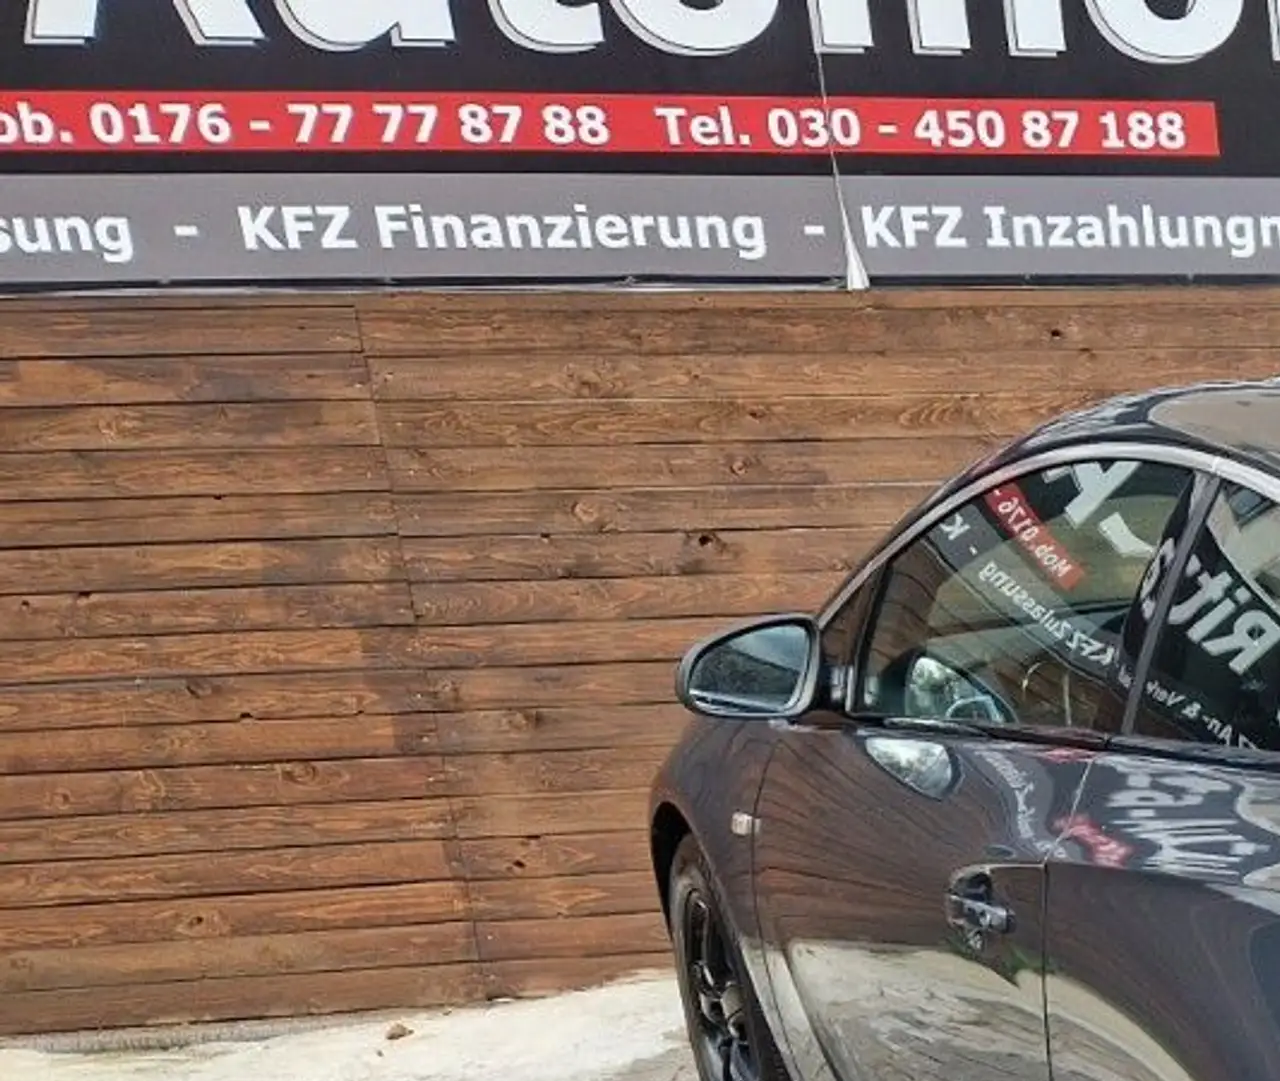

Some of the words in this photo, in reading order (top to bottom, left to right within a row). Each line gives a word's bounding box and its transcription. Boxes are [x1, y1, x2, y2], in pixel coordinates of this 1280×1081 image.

[89, 102, 231, 145] 0176
[249, 120, 270, 131] -
[287, 103, 353, 143] 77
[372, 104, 438, 143] 77
[458, 103, 522, 144] 87
[542, 104, 610, 145] 88
[654, 106, 751, 146] Tel.
[768, 108, 861, 148] 030
[878, 125, 897, 133] -
[914, 110, 1005, 148] 450
[1022, 110, 1079, 148] 87
[1099, 111, 1187, 150] 188
[174, 225, 198, 236] -
[237, 205, 359, 250] KFZ
[374, 203, 767, 260] Finanzierung
[803, 225, 825, 235] -
[861, 205, 968, 248] KFZ
